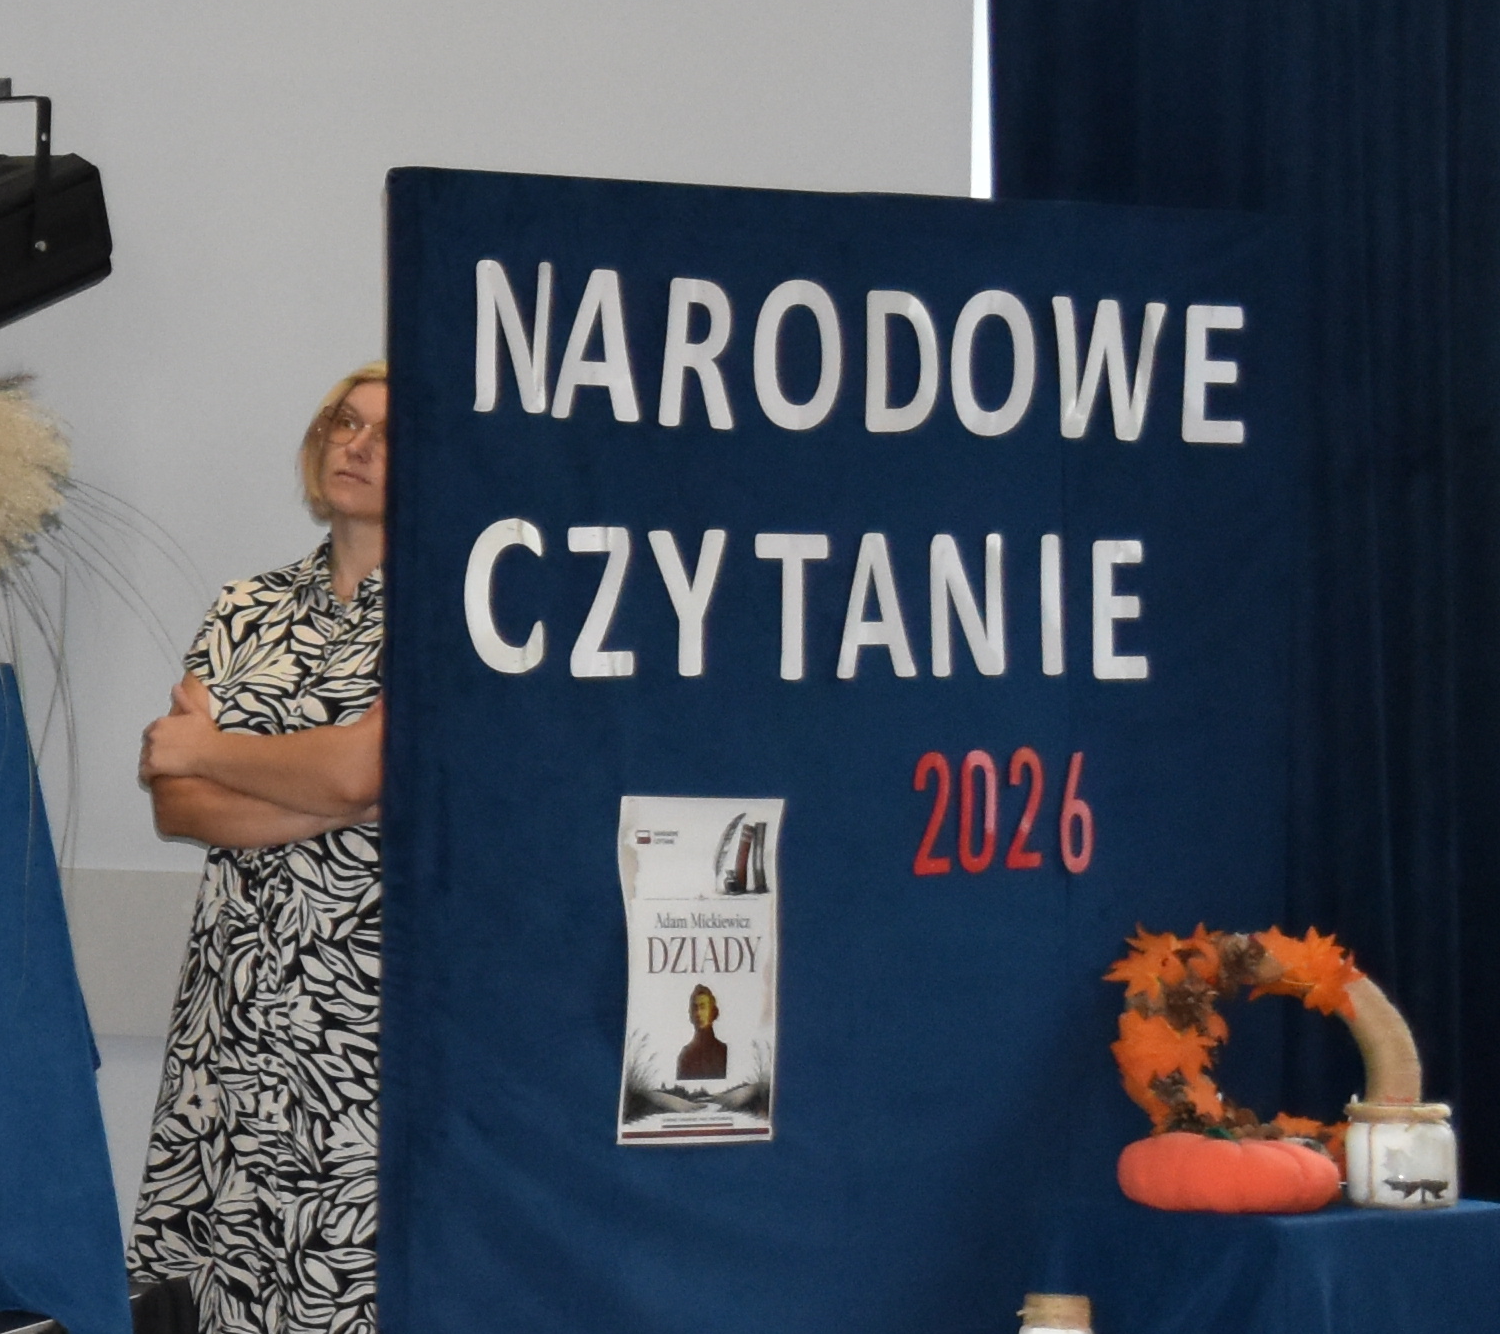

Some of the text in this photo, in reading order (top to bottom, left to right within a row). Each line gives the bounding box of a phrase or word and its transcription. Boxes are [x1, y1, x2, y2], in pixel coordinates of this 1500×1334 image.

[473, 259, 1245, 444] NARODOWE
[463, 517, 1149, 681] CZYTANIE
[913, 746, 1094, 876] 2026
[647, 936, 762, 974] DZIADY
[655, 912, 750, 929] Adam Mickiewicz
